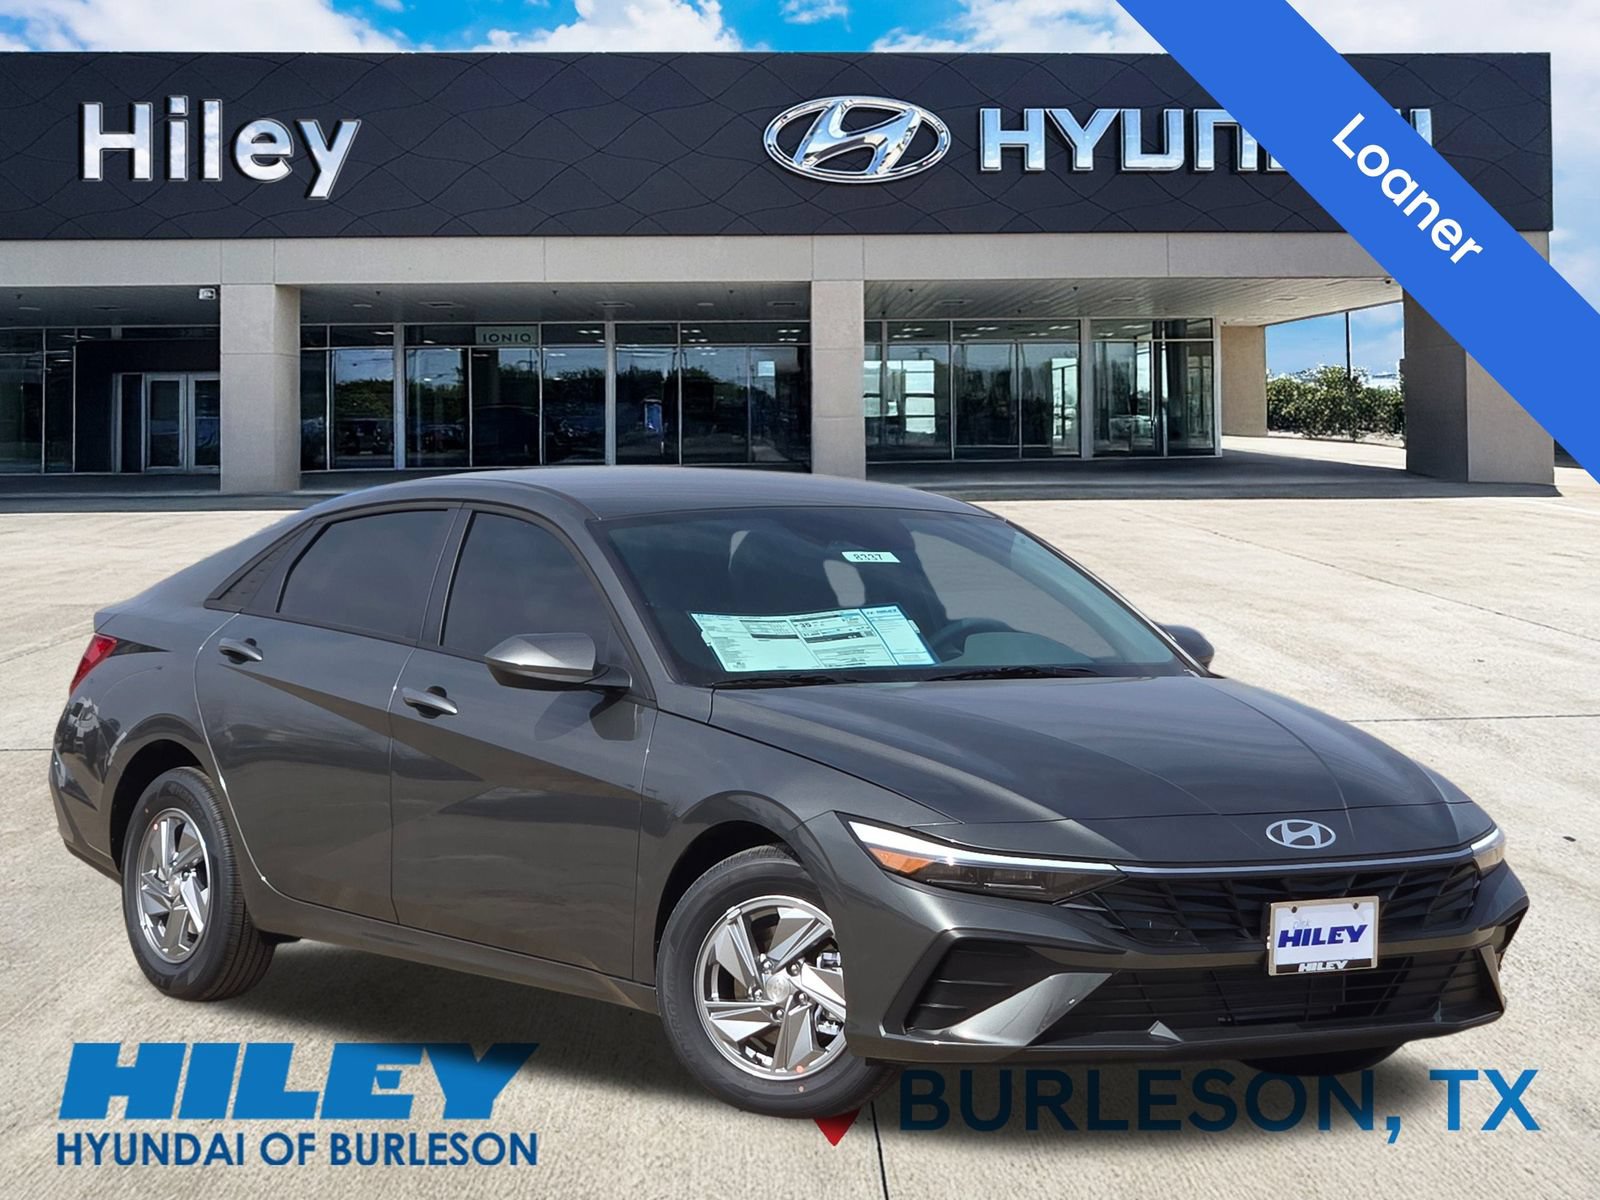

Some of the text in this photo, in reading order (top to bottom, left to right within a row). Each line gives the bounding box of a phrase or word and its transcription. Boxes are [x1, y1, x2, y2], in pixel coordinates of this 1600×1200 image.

[81, 95, 362, 200] Hiley
[482, 332, 532, 343] IONIQ
[1277, 923, 1369, 948] HILEY
[1297, 960, 1349, 973] HILEY
